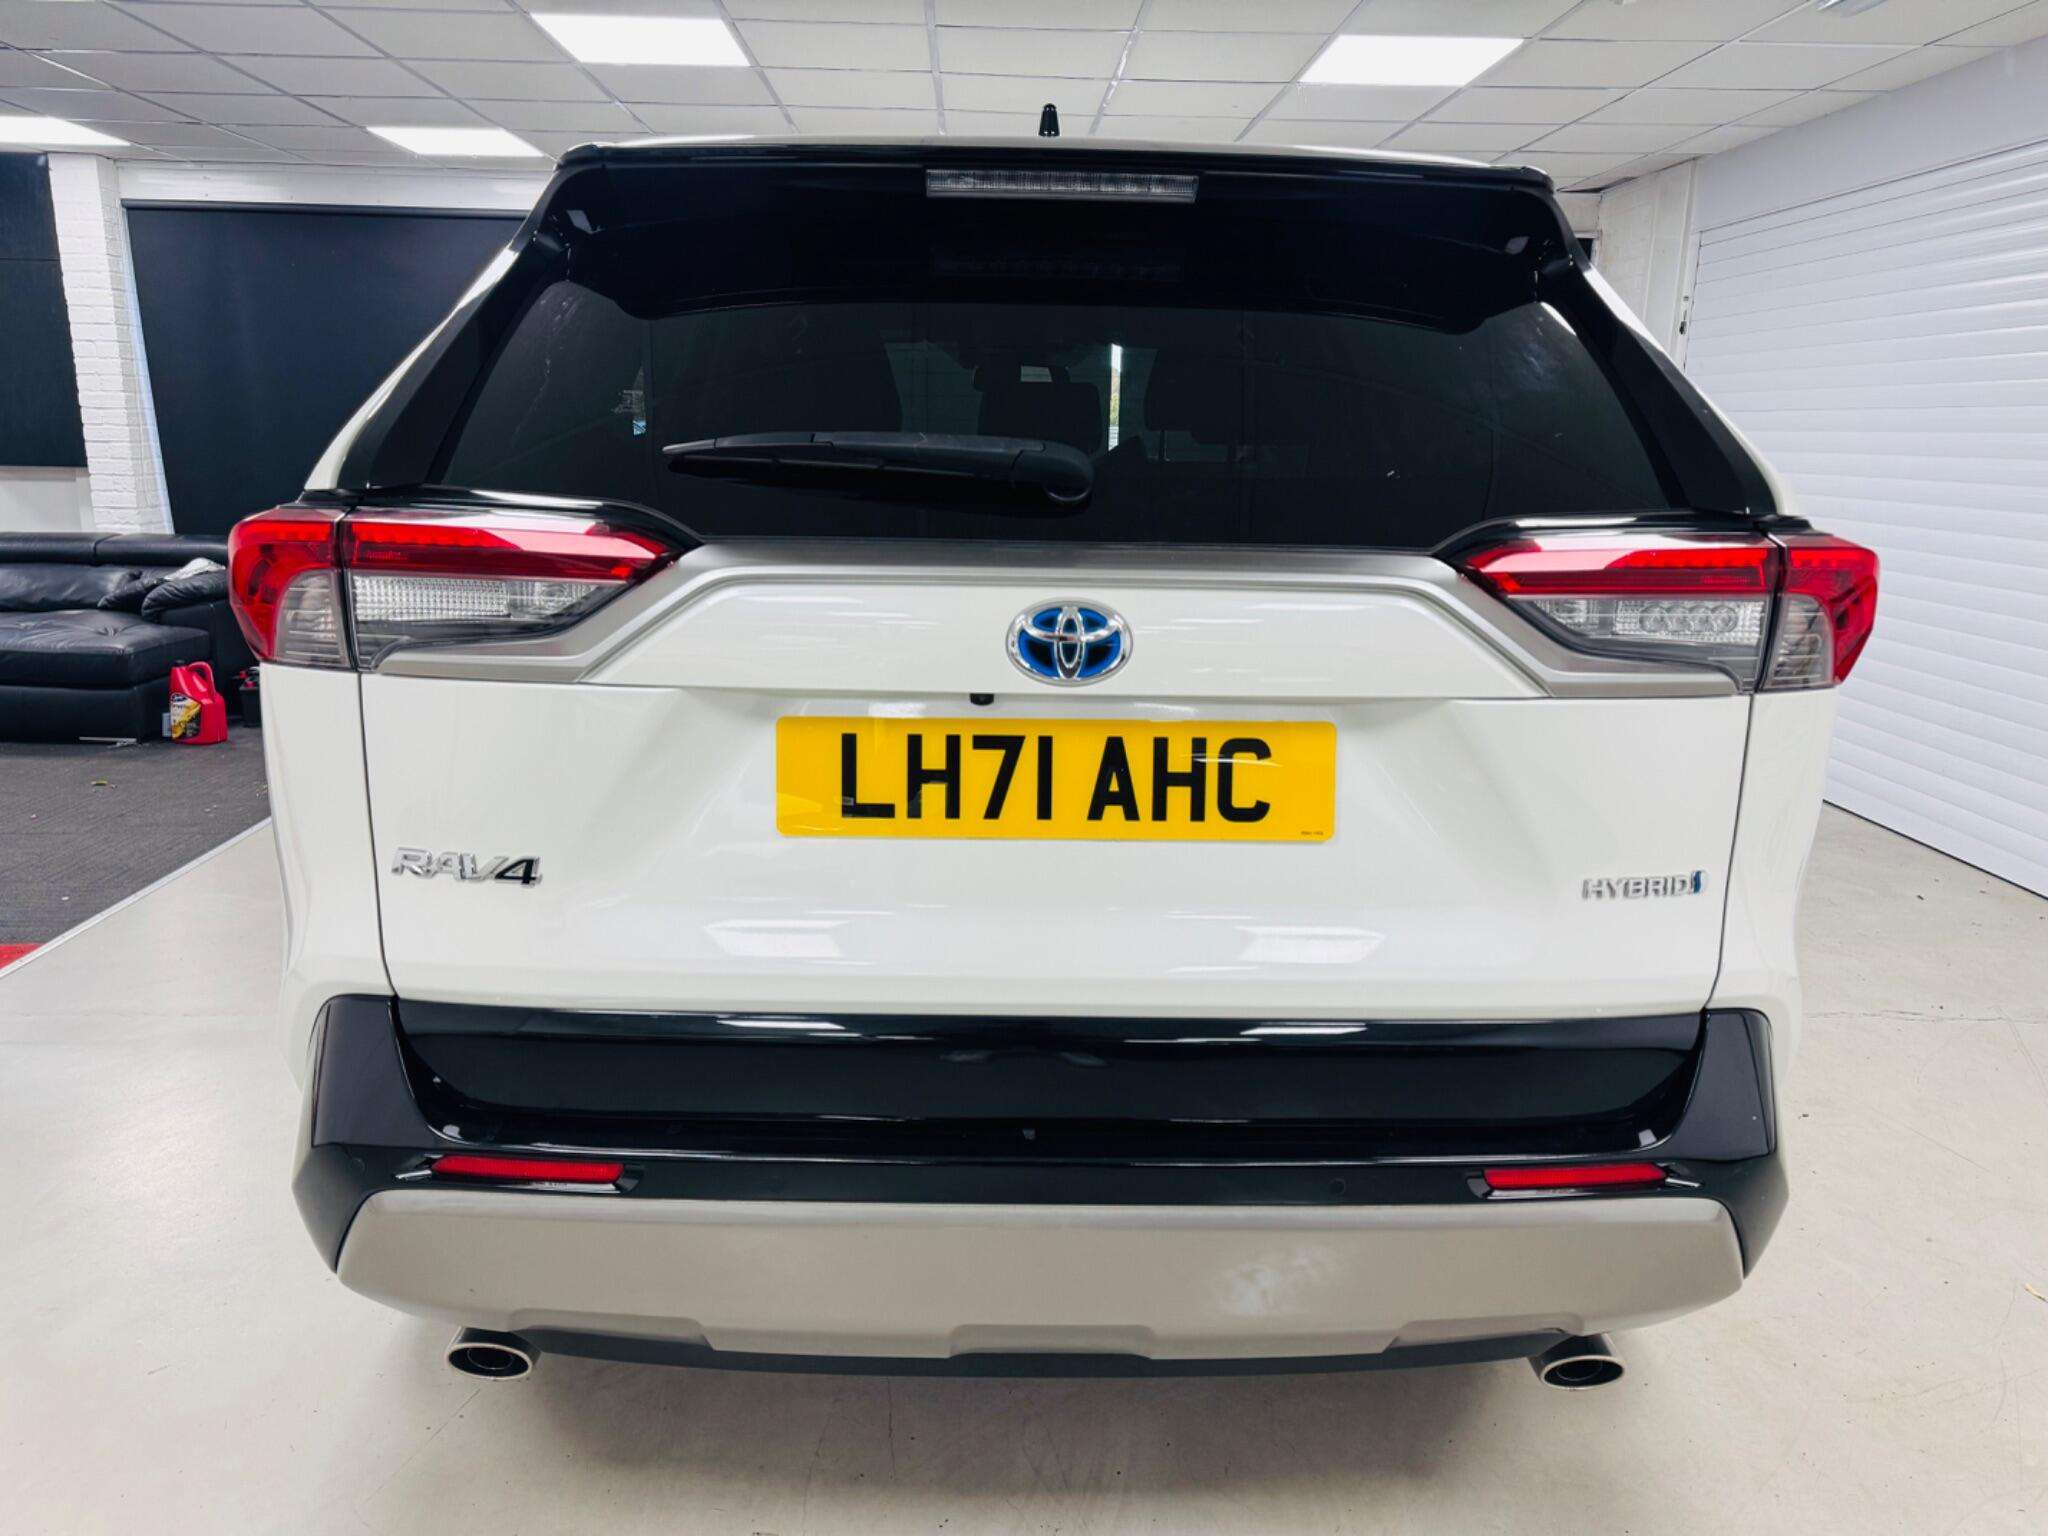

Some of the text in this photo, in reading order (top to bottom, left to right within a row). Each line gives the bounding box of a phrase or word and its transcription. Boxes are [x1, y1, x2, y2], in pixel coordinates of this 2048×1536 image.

[841, 732, 1273, 823] LH71 AHC
[391, 847, 544, 887] RAV4
[1582, 875, 1689, 900] HYBRID
